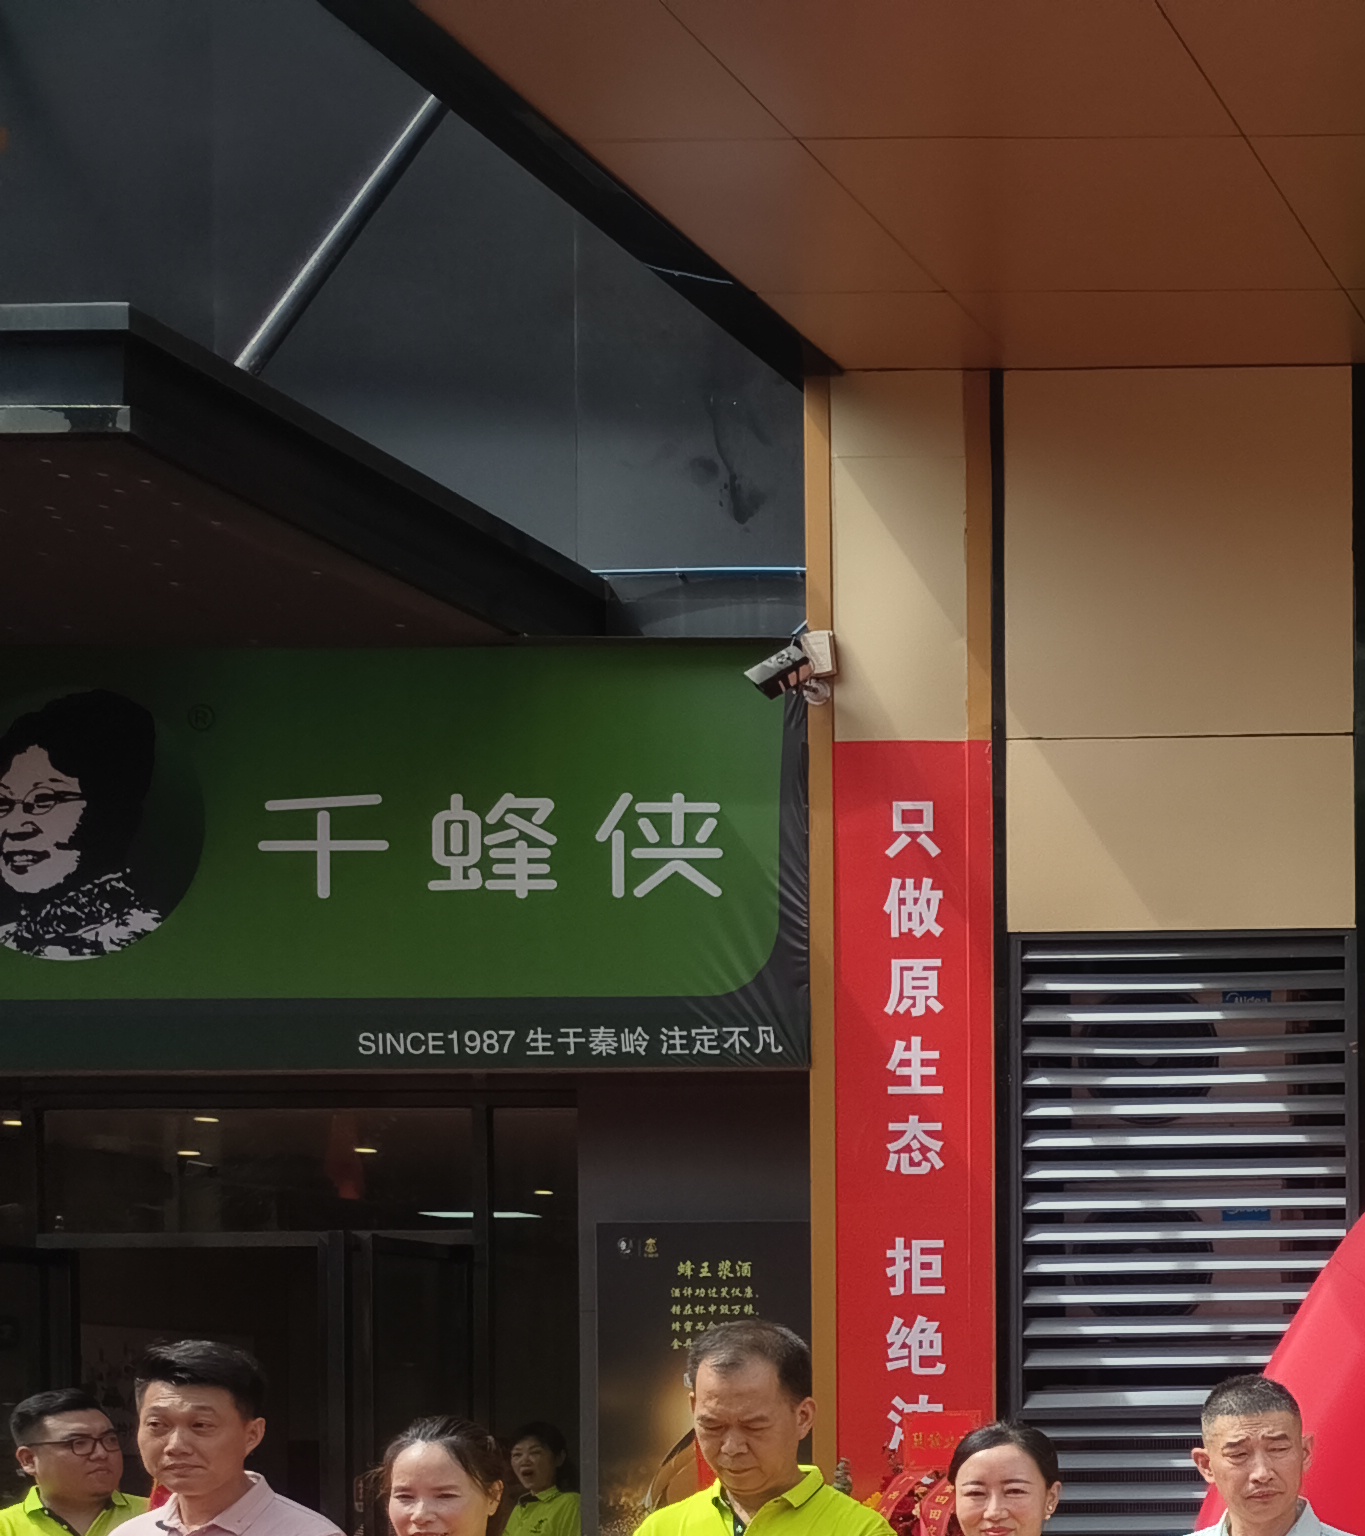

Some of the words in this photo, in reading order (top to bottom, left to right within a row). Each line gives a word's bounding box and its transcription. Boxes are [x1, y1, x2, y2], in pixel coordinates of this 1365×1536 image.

[257, 791, 724, 899] 千蜂侠
[883, 800, 945, 1176] 只做原生态
[358, 1029, 516, 1056] SINCE1987
[525, 1027, 649, 1056] 生于秦岭
[659, 1026, 784, 1055] 注定不凡
[677, 1259, 753, 1280] 蜂王浆酒
